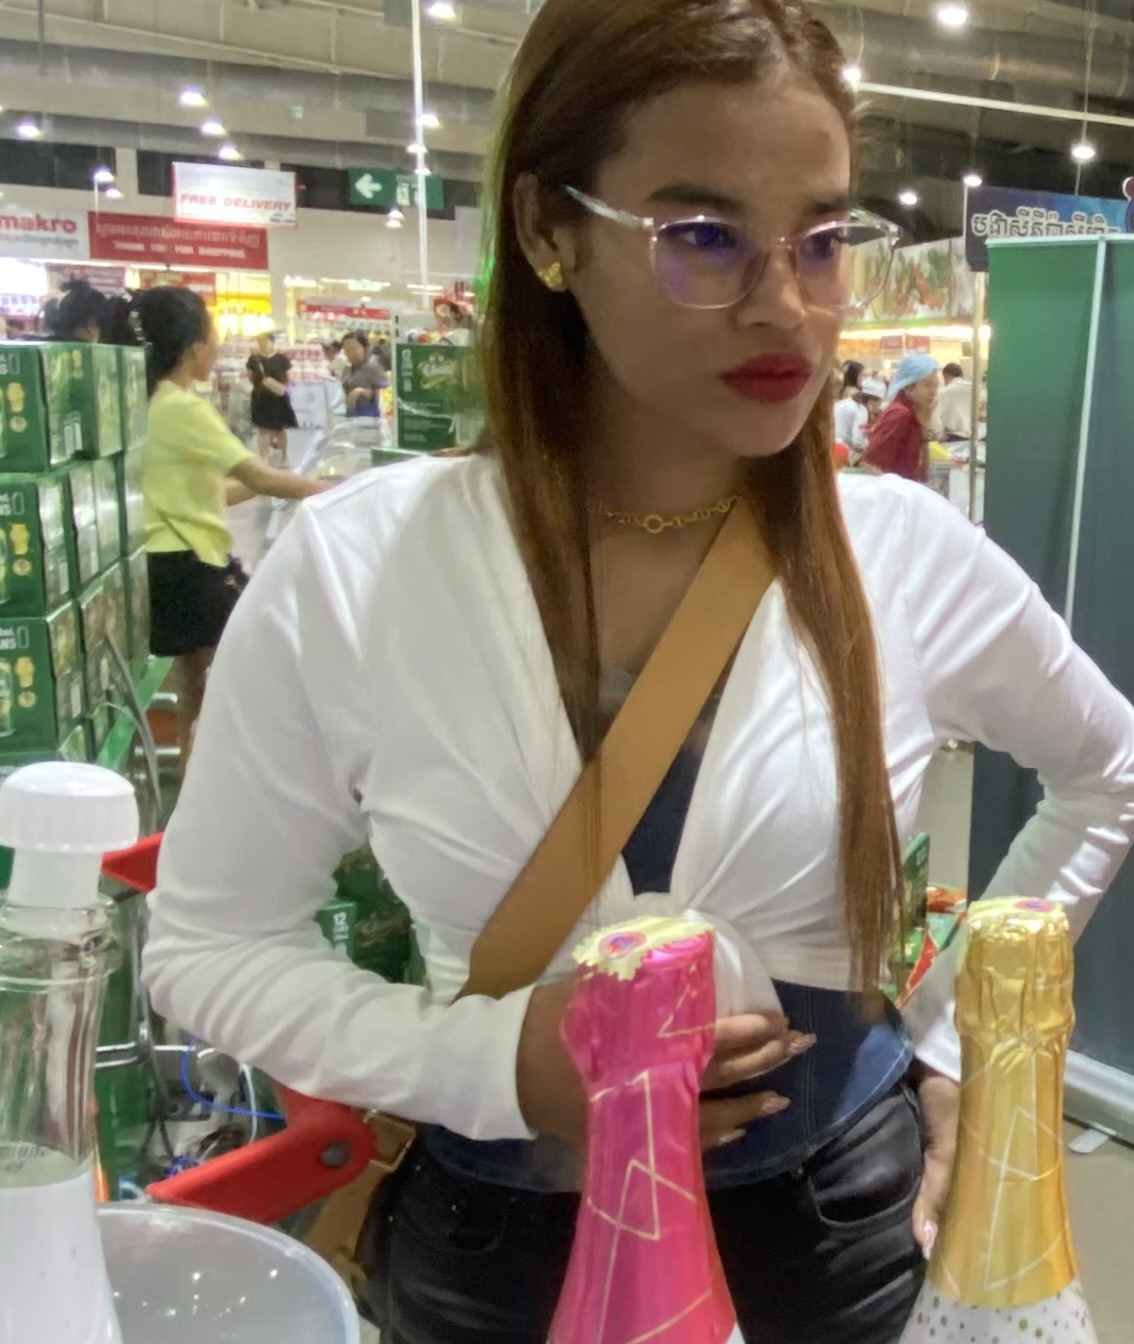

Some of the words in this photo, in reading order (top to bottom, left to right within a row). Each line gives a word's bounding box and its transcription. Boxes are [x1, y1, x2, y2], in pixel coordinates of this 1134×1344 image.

[180, 193, 217, 205] FREE
[223, 197, 292, 211] DELIVERY
[0, 212, 77, 233] makro
